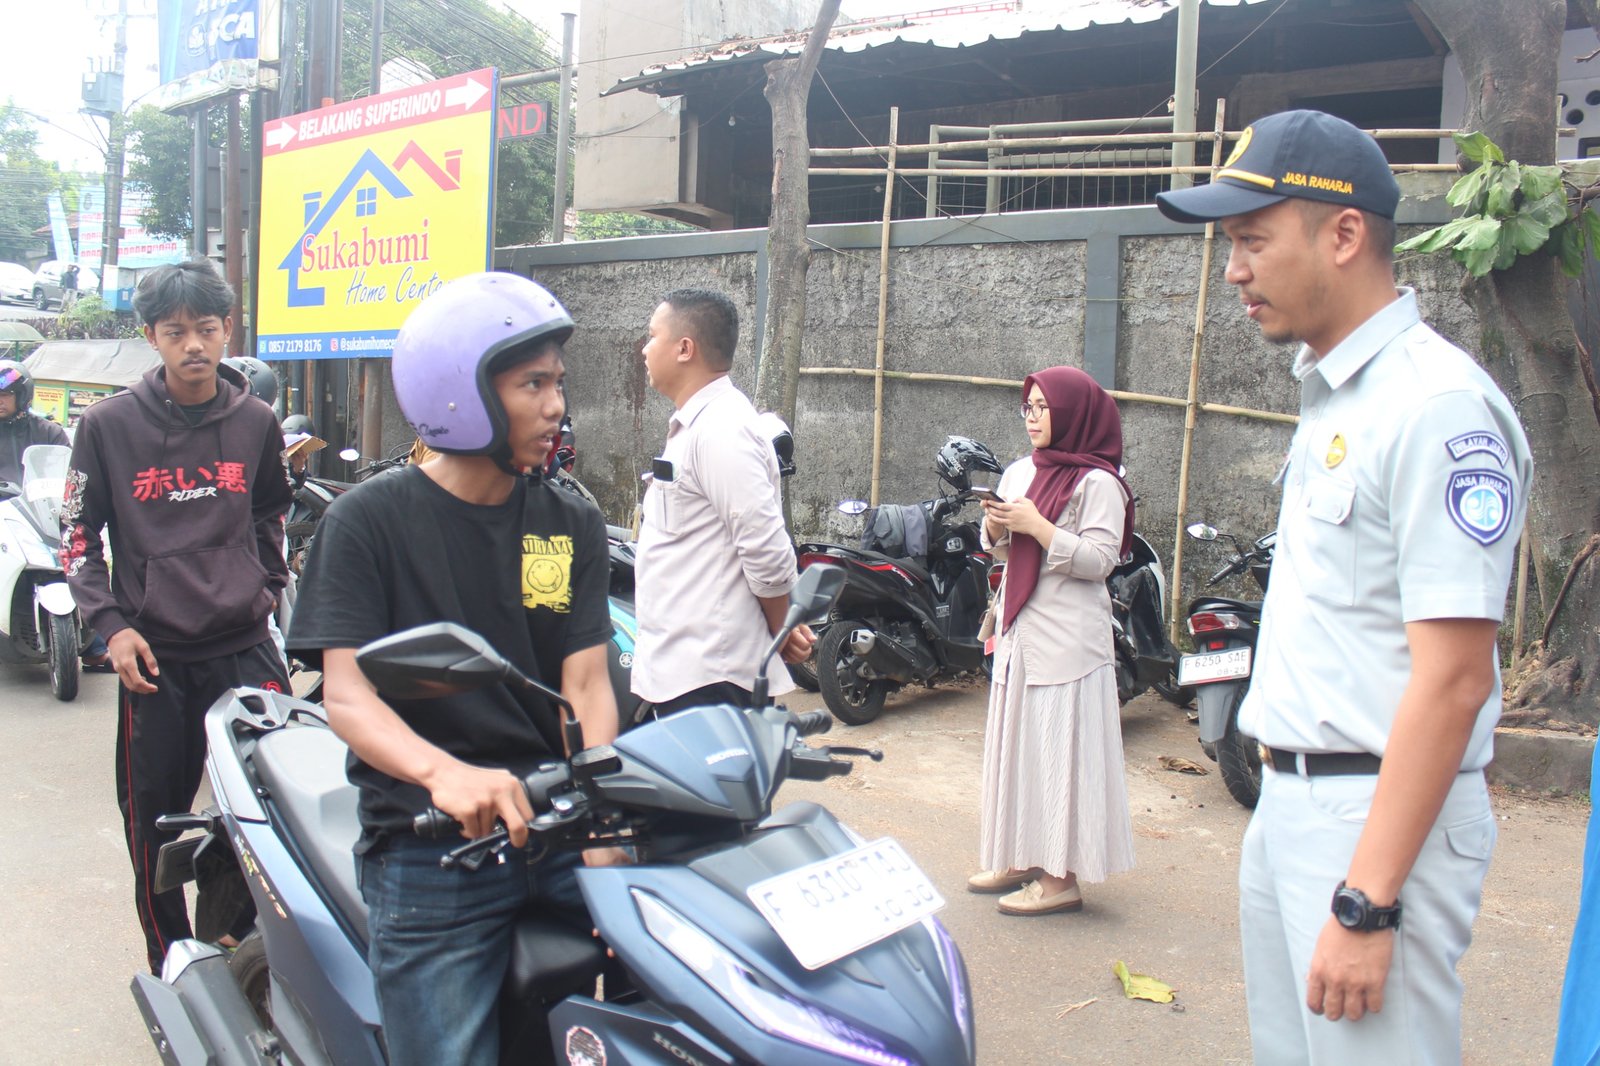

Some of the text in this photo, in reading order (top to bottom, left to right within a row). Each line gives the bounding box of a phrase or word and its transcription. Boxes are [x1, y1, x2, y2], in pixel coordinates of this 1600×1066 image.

[298, 90, 441, 141] BELAKANG SUPERINDO
[1282, 172, 1353, 194] JASA RAHARJA
[301, 218, 429, 273] Sukabumi
[345, 266, 455, 305] Home Cente
[268, 341, 284, 353] 0857
[286, 340, 303, 353] 2179
[304, 339, 322, 352] 8176
[132, 461, 248, 502] 赤い悪
[1455, 476, 1508, 496] JASA RAHARJA
[168, 486, 218, 502] RIDER
[522, 538, 573, 555] NIRVANA
[1184, 659, 1191, 669] F
[763, 892, 785, 923] F
